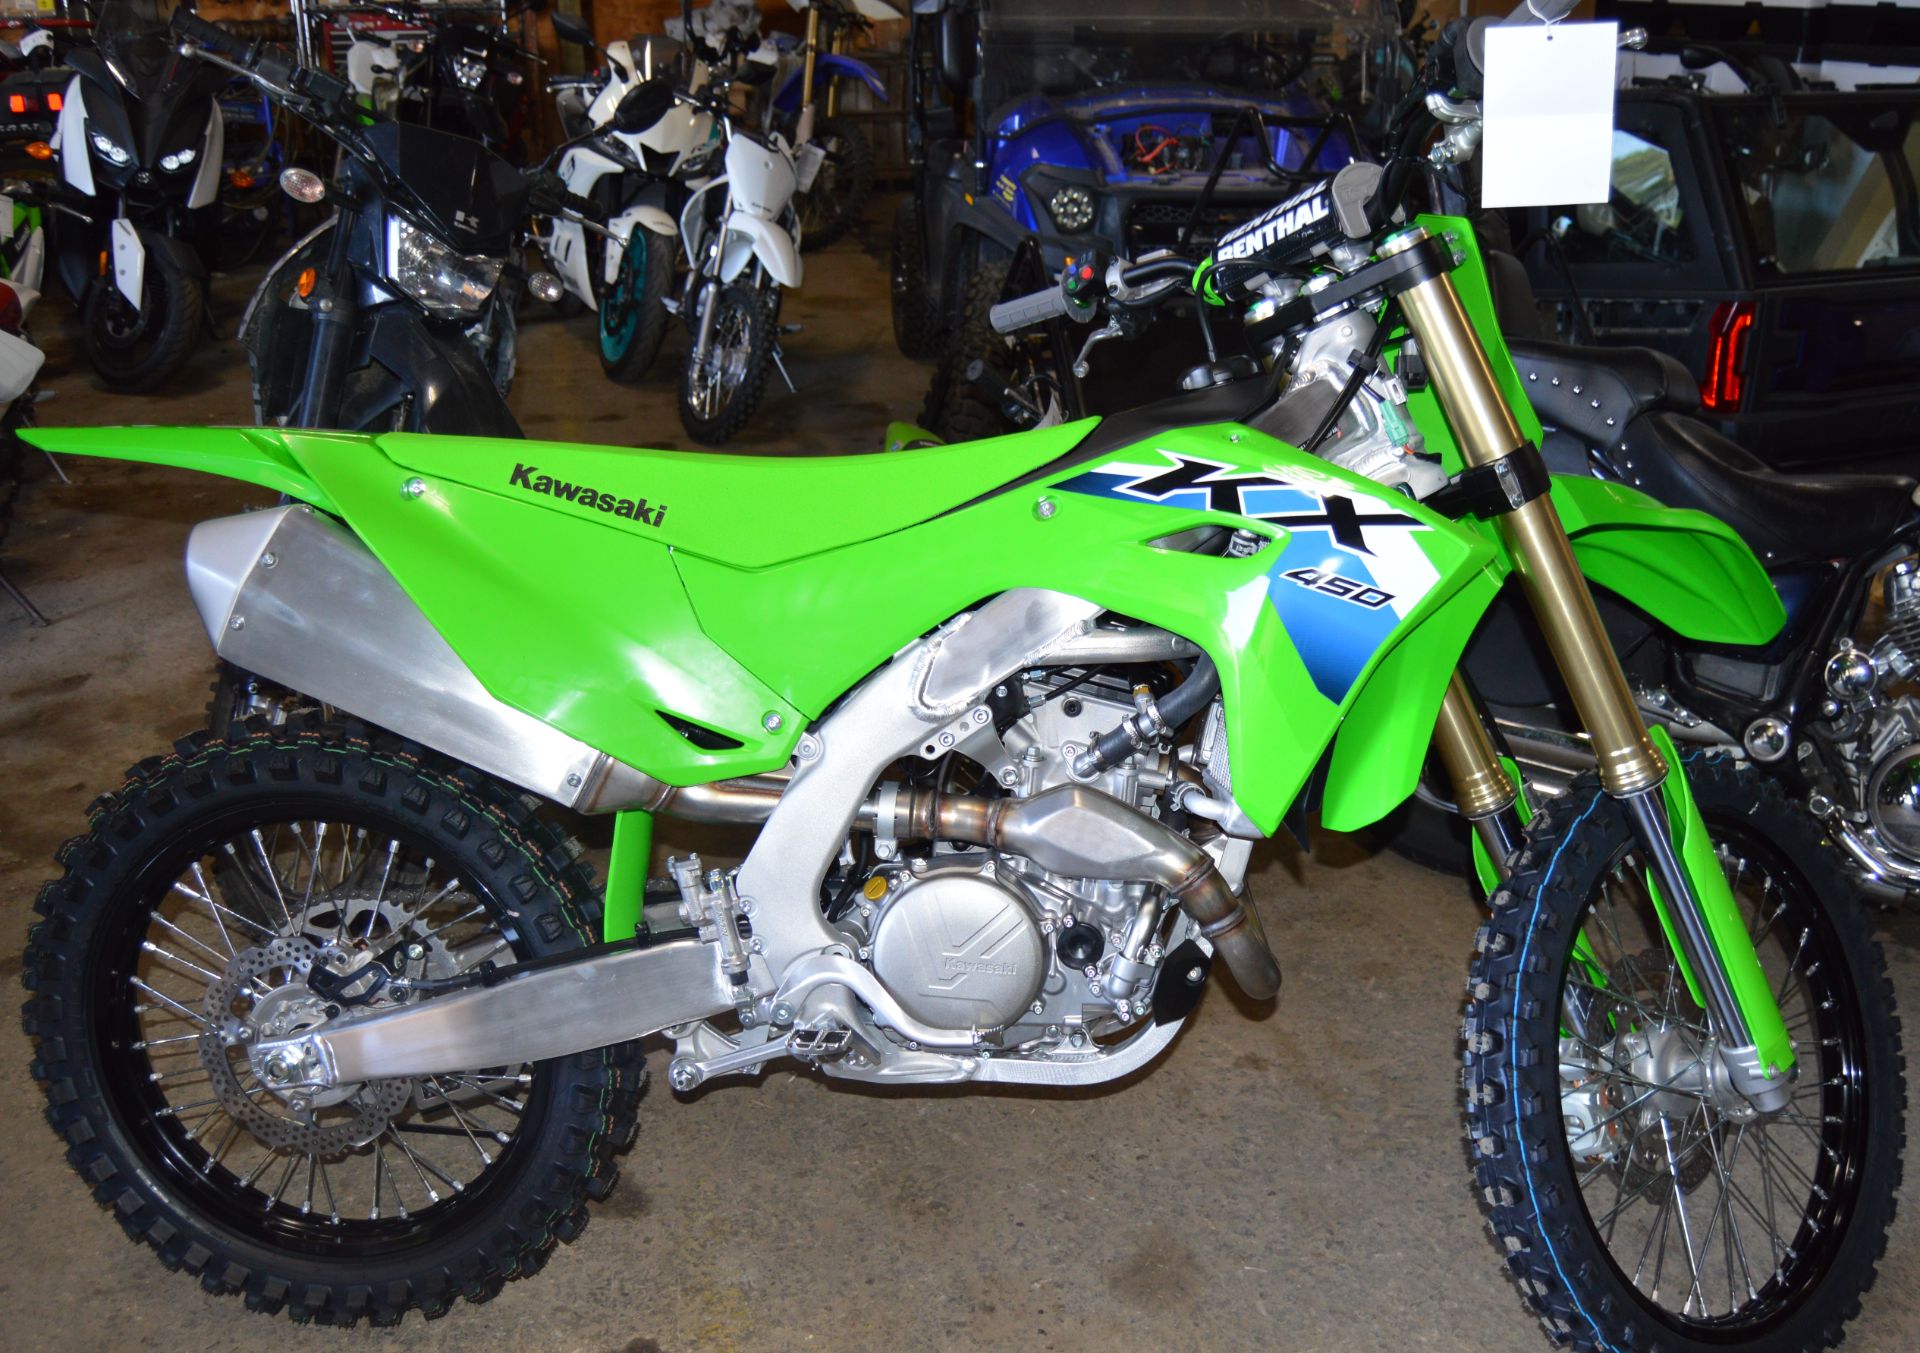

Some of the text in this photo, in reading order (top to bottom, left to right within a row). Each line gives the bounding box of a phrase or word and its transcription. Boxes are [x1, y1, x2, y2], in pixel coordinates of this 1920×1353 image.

[1217, 194, 1330, 262] RENTHAL
[508, 462, 668, 529] Kawasaki
[1282, 567, 1396, 609] 450
[943, 956, 1017, 977] Kawasaki
